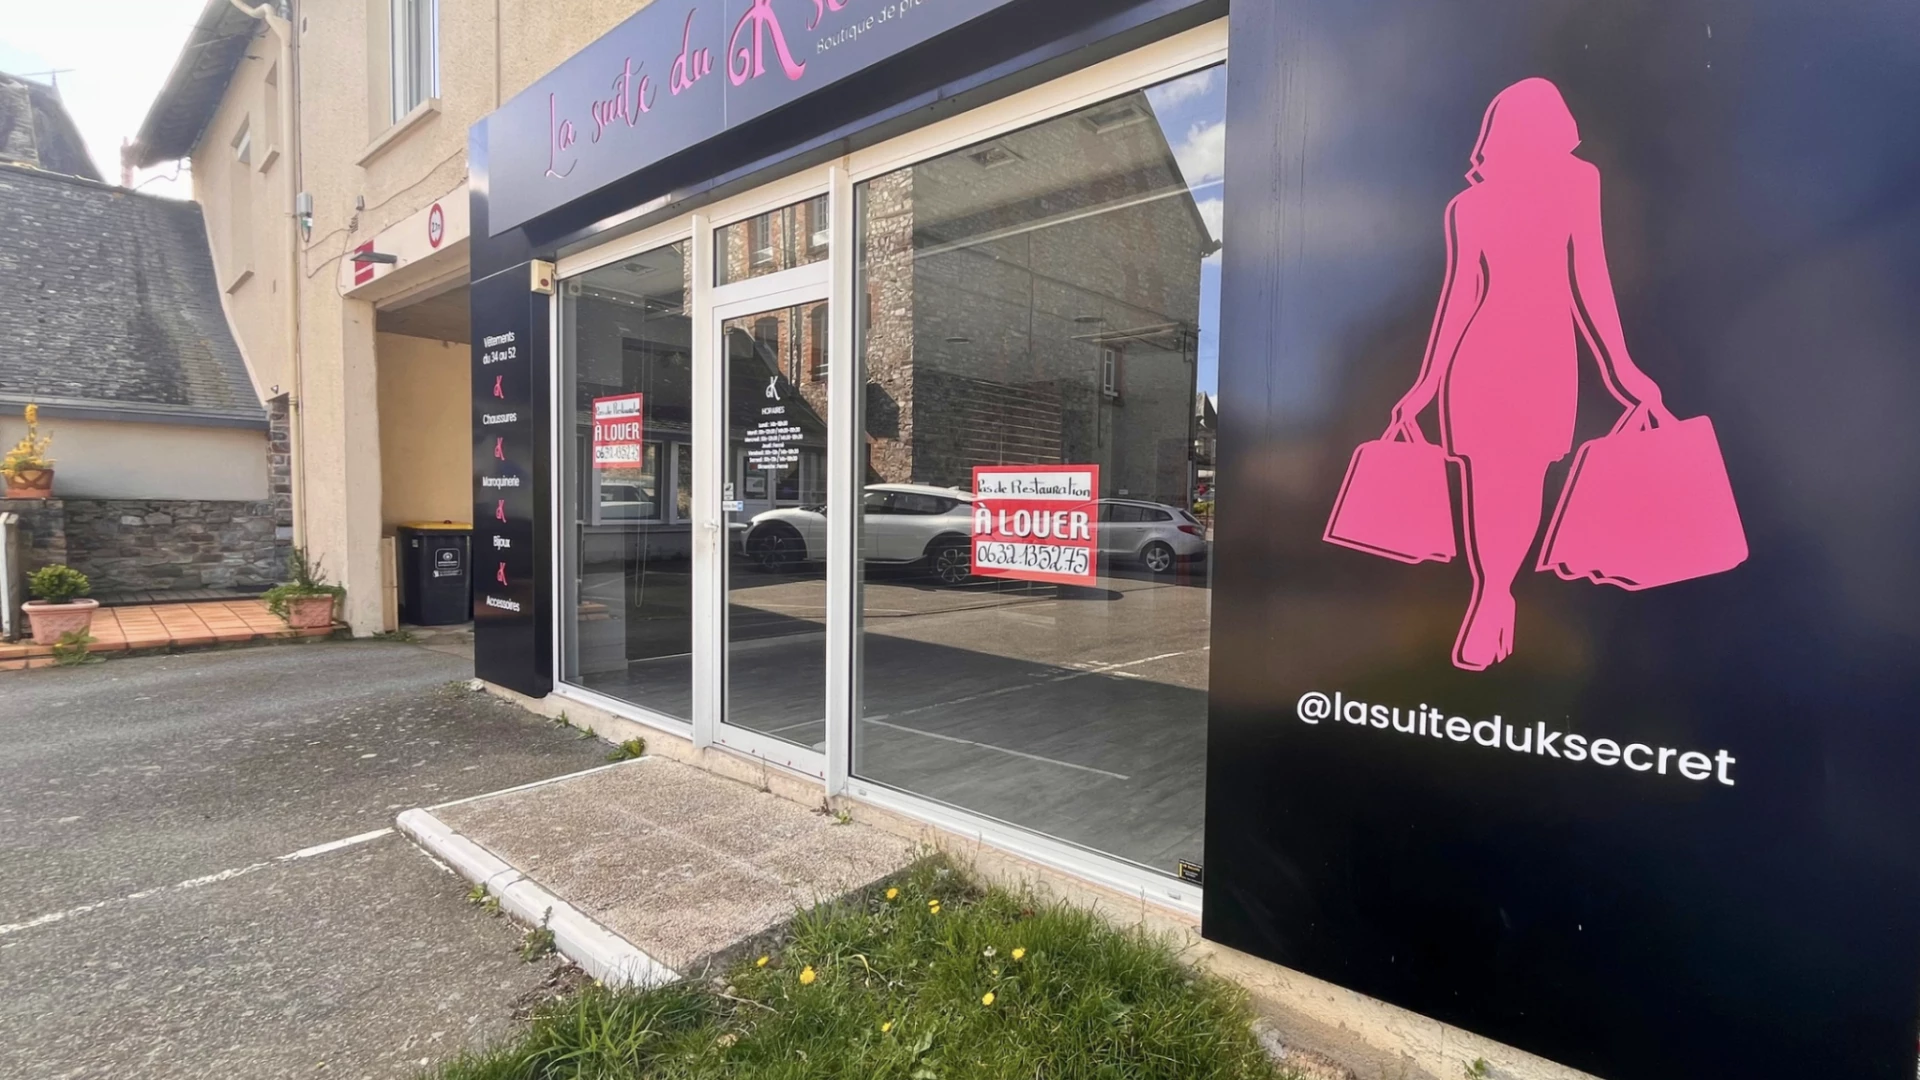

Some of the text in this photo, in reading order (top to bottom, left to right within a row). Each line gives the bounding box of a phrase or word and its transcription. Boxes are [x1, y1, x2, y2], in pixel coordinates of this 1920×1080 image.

[816, 16, 875, 54] Boutique
[878, 5, 896, 24] de
[544, 92, 578, 179] La
[592, 57, 657, 144] suite
[670, 7, 715, 96] du
[483, 331, 515, 348] Vêtements
[483, 346, 516, 365] du 34 au 52
[482, 412, 517, 425] Chaussures
[595, 421, 640, 441] À LOUER
[482, 475, 520, 490] Maroquinerie
[977, 479, 993, 493] Pas
[994, 480, 1008, 493] de
[975, 502, 1091, 540] À LOUER
[493, 535, 511, 550] Bijoux
[486, 594, 521, 613] Accessoires
[1296, 690, 1736, 787] @lasuiteduksecret
